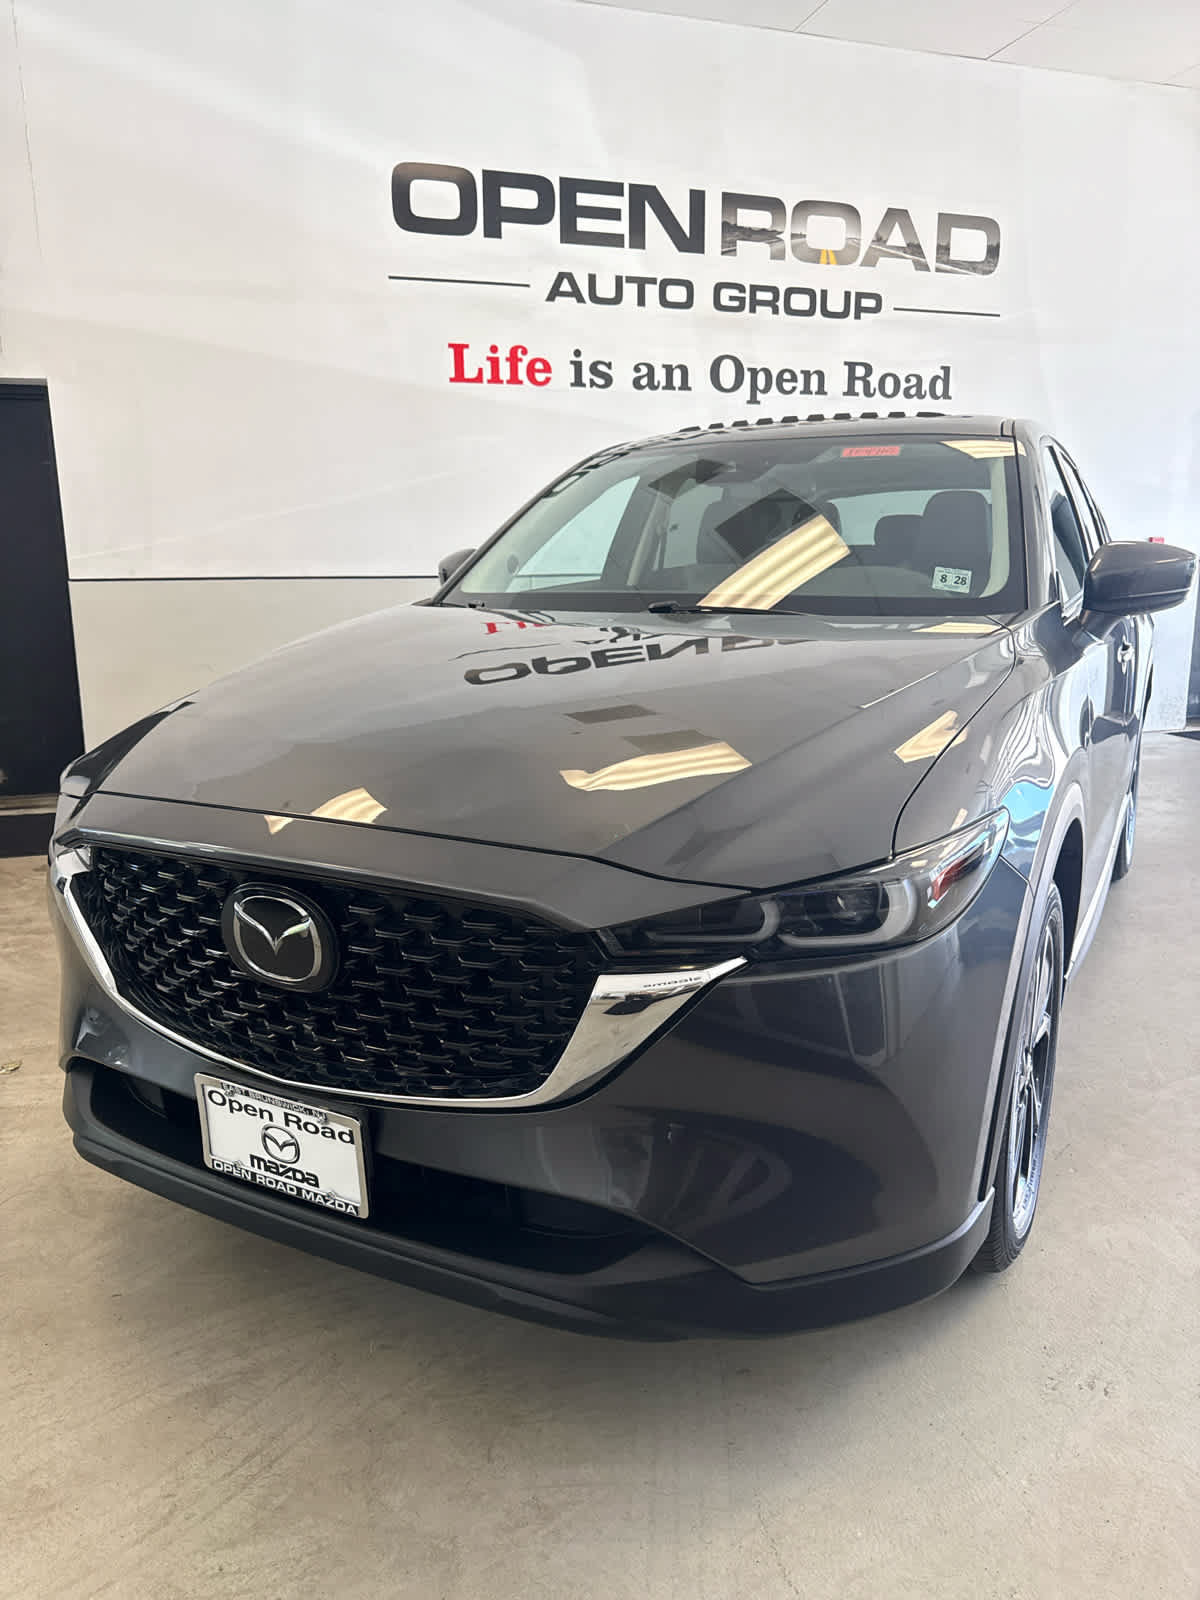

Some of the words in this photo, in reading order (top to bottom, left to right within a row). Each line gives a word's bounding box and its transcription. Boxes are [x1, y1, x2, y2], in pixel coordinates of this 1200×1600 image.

[391, 161, 706, 255] OPEN
[720, 192, 1001, 276] ROAD
[545, 271, 695, 310] AUTO
[712, 282, 883, 320] GROUP
[448, 343, 552, 387] Life
[569, 349, 614, 389] is
[632, 359, 692, 392] an
[709, 354, 828, 404] Open
[842, 361, 952, 401] Road
[940, 574, 948, 583] 8
[954, 575, 967, 586] 28
[207, 1089, 273, 1122] Open
[284, 1112, 355, 1145] Road
[213, 1161, 251, 1179] OPEN
[256, 1175, 298, 1195] ROAD
[302, 1190, 358, 1216] MAZDA
